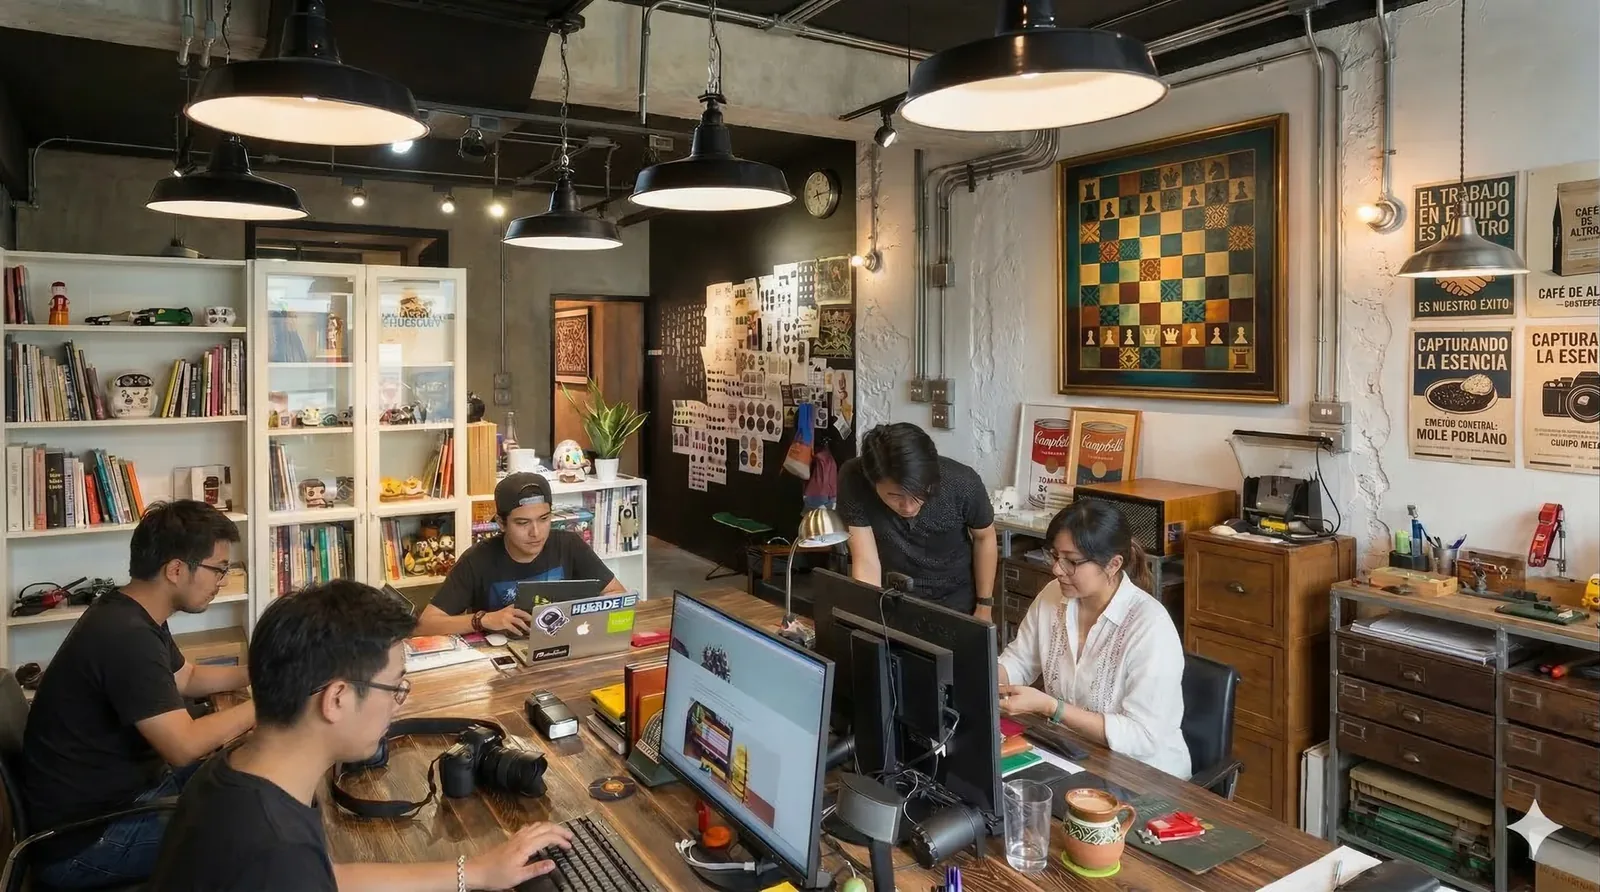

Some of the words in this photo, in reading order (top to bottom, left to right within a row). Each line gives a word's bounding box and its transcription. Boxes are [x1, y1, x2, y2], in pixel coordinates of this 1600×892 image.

[1419, 191, 1437, 207] EL
[1420, 207, 1440, 226] EN
[1446, 199, 1510, 223] EUIPO
[1419, 226, 1436, 241] ES
[1441, 218, 1510, 240] NUTRO
[1538, 285, 1566, 299] CAFÉ
[1569, 286, 1583, 298] DE
[1419, 301, 1430, 313] ES
[1432, 300, 1477, 312] NUESTRO
[1417, 337, 1508, 352] CAPTURANDO
[1532, 332, 1599, 347] CAPTURA
[1418, 353, 1436, 370] LA
[1441, 353, 1508, 371] ESENCIA
[1537, 349, 1554, 364] LA
[1559, 349, 1598, 364] ESEN
[1416, 429, 1448, 441] MOLE
[1451, 430, 1508, 446] POBLANO
